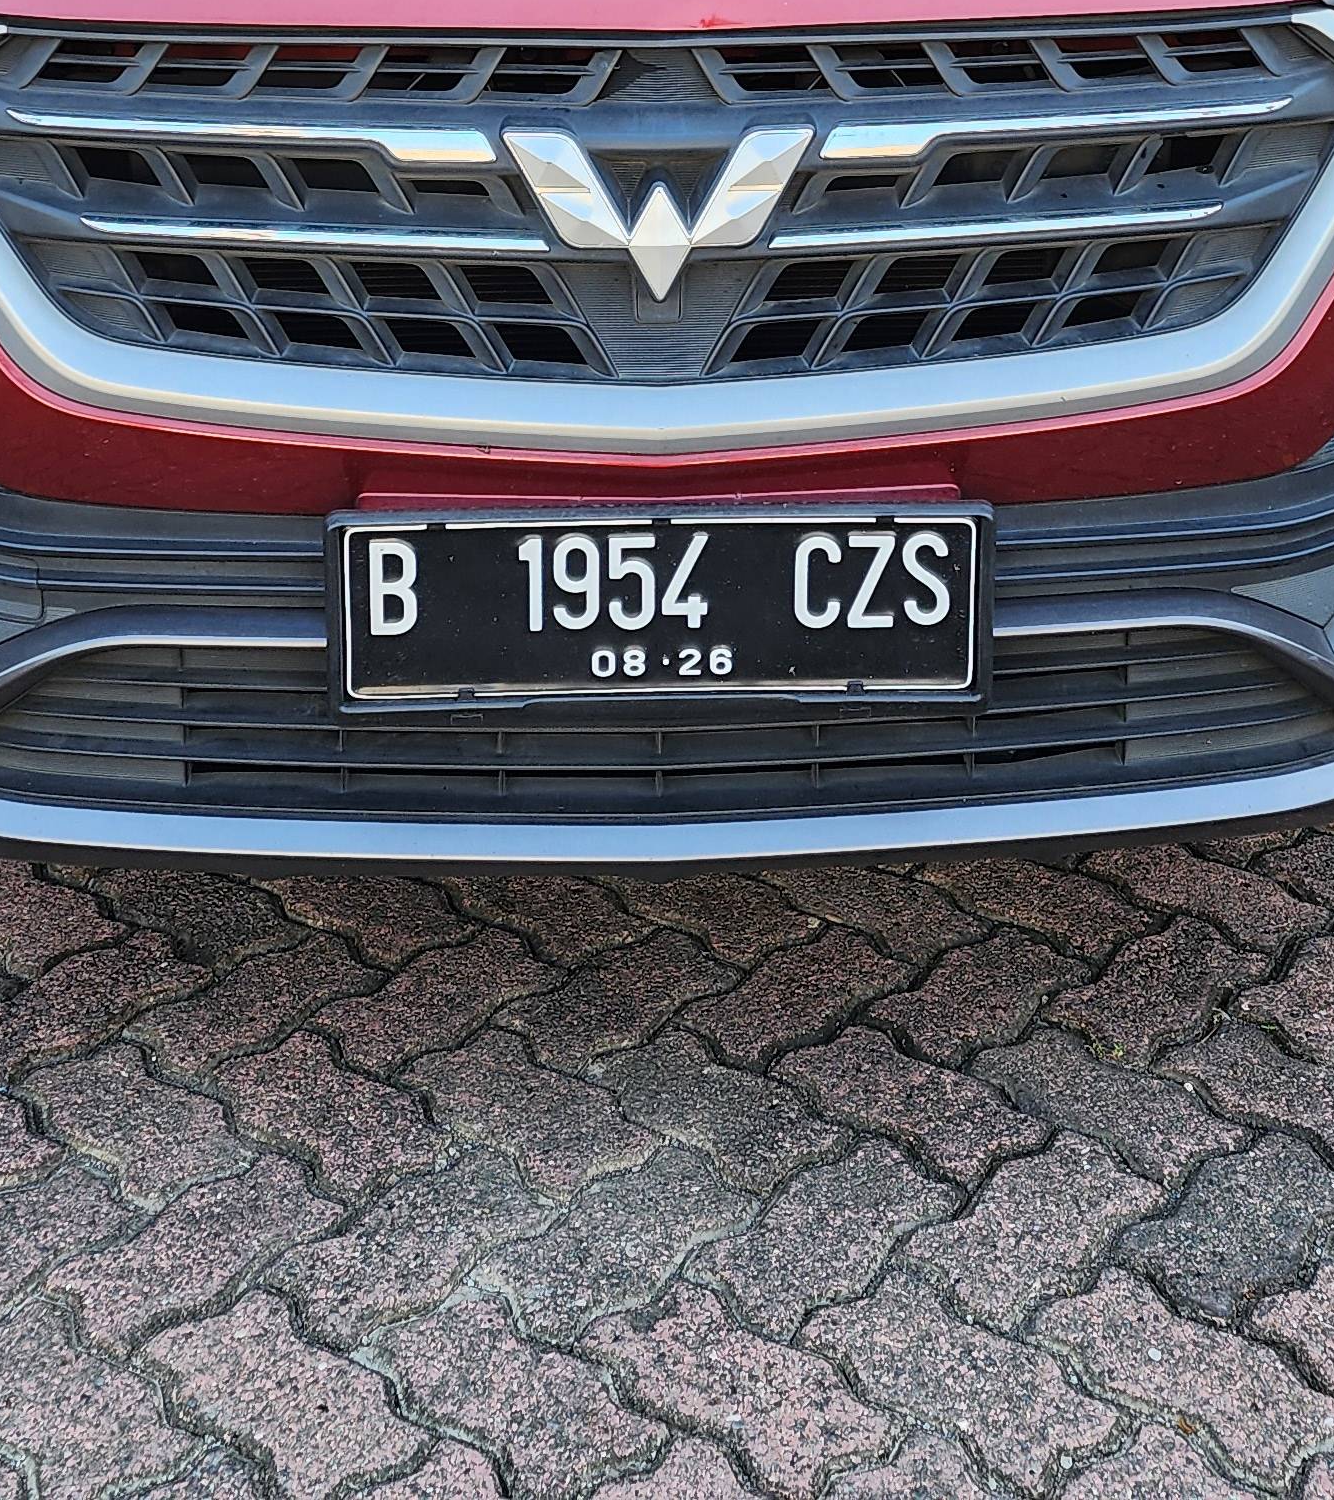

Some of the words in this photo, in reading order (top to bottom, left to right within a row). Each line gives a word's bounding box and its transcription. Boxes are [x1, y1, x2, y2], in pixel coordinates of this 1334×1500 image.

[369, 537, 419, 636] B
[518, 531, 710, 632] 1954
[793, 531, 952, 630] CZS
